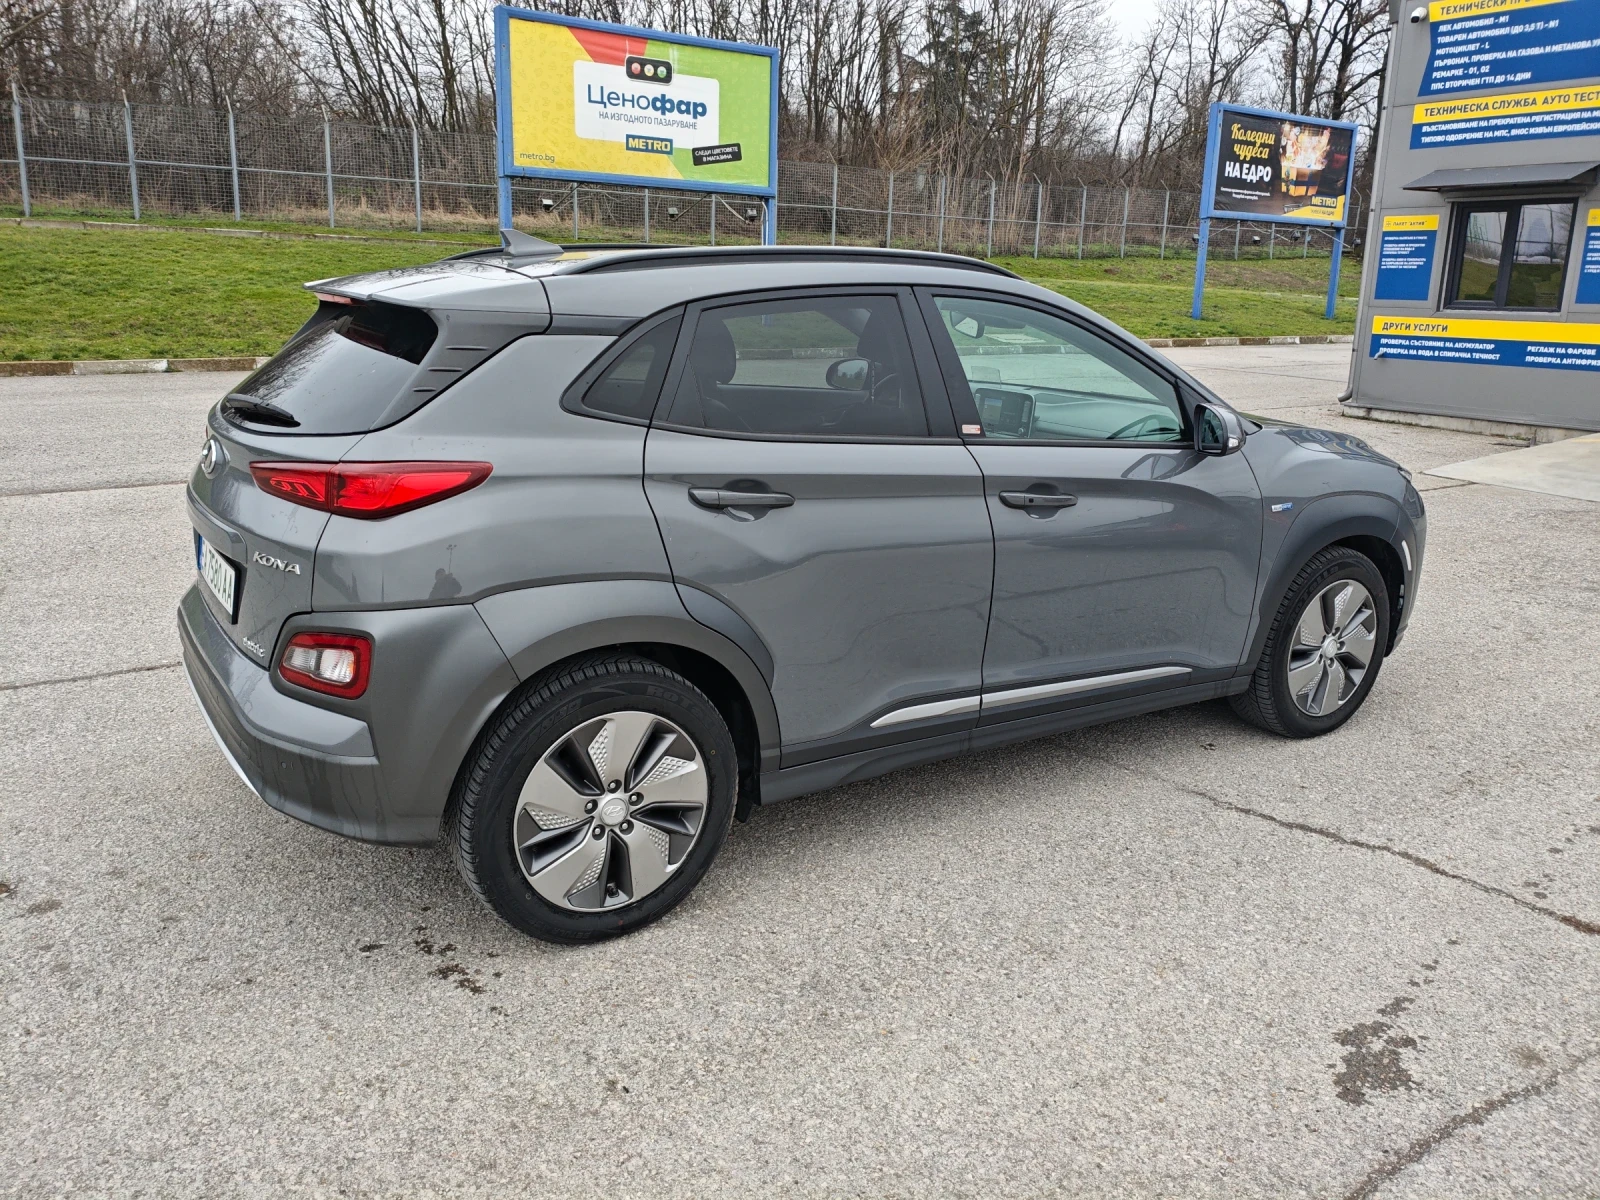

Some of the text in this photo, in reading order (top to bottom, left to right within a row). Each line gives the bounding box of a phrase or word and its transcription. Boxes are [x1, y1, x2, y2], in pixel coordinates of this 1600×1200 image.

[1440, 0, 1507, 16] ТЕХНИЧЕСКИ
[1452, 17, 1494, 30] АВТОМОБИЛ
[1437, 33, 1467, 44] ТОВАРЕН
[1468, 26, 1510, 39] АВТОМОБИЛ
[1436, 43, 1480, 55] МОТОЦИКЛЕТ
[1471, 51, 1506, 62] ПРОВЕРКА
[1507, 50, 1517, 58] НА
[1518, 47, 1544, 56] ГАЗОВА
[1551, 40, 1591, 52] МЕТАНОВА
[1432, 68, 1464, 79] РЕМАРКЕ
[1445, 78, 1480, 89] ВТОРИЧЕН
[1495, 75, 1505, 84] ДО
[1515, 72, 1532, 81] ДНИ
[587, 84, 707, 119] Ценофар
[1424, 91, 1600, 117] ТЕХНИЧЕСКА СЛУЖБА АУТО ТЕСТ
[599, 111, 697, 130] НА ИЗГОДНОТО ПАЗАРУВАНЕ
[1479, 119, 1488, 127] НА
[1489, 116, 1530, 126] ПРЕКРАТЕНА
[1531, 112, 1581, 122] РЕГИСТРАЦИЯ
[1231, 123, 1275, 147] Коледни
[1446, 132, 1483, 142] ОДОБРЕНИЕ
[1511, 127, 1529, 135] ВНОС
[628, 138, 670, 151] METRO
[520, 152, 555, 163] metro.bg
[1234, 144, 1270, 161] чудеса
[1225, 161, 1272, 183] НА ЕДРО
[1312, 196, 1337, 207] METRO
[1382, 322, 1448, 332] ДРУГИ УСЛУГИ
[1380, 338, 1409, 346] ПРОВЕРКА
[1454, 342, 1495, 350] АКУМУЛАТОР
[1440, 351, 1471, 359] СПИРАЧНА
[1567, 348, 1597, 356] ФАРОВЕ
[1525, 356, 1561, 364] ПРОВЕРКА
[253, 551, 301, 575] KONA
